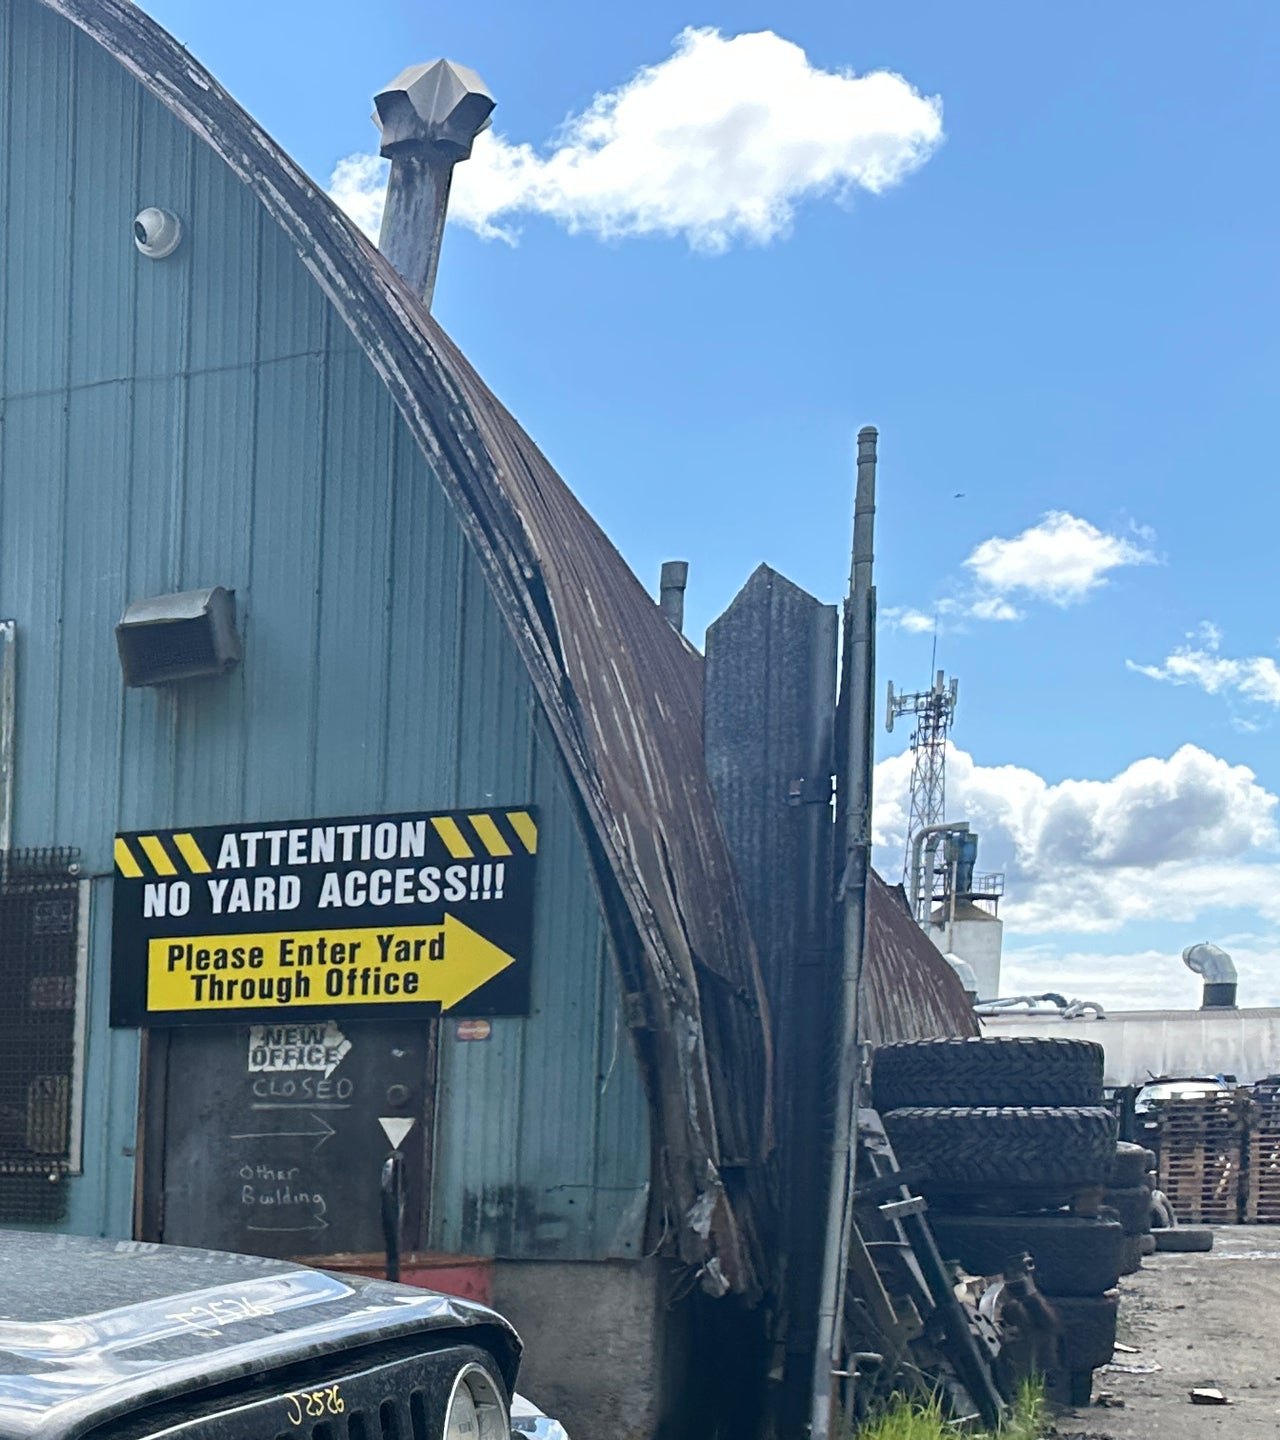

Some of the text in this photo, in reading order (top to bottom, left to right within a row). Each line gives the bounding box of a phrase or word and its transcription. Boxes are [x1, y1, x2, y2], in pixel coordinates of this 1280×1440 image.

[216, 820, 426, 871] ATTENTION
[143, 863, 506, 918] NO YARD ACCESS!!!
[167, 932, 446, 972] Please Enter Yard
[190, 966, 419, 1004] Through Office
[265, 1026, 324, 1045] NEW
[251, 1045, 339, 1067] OFFICE
[252, 1076, 353, 1099] CLOSED
[284, 1384, 345, 1426] J2526
